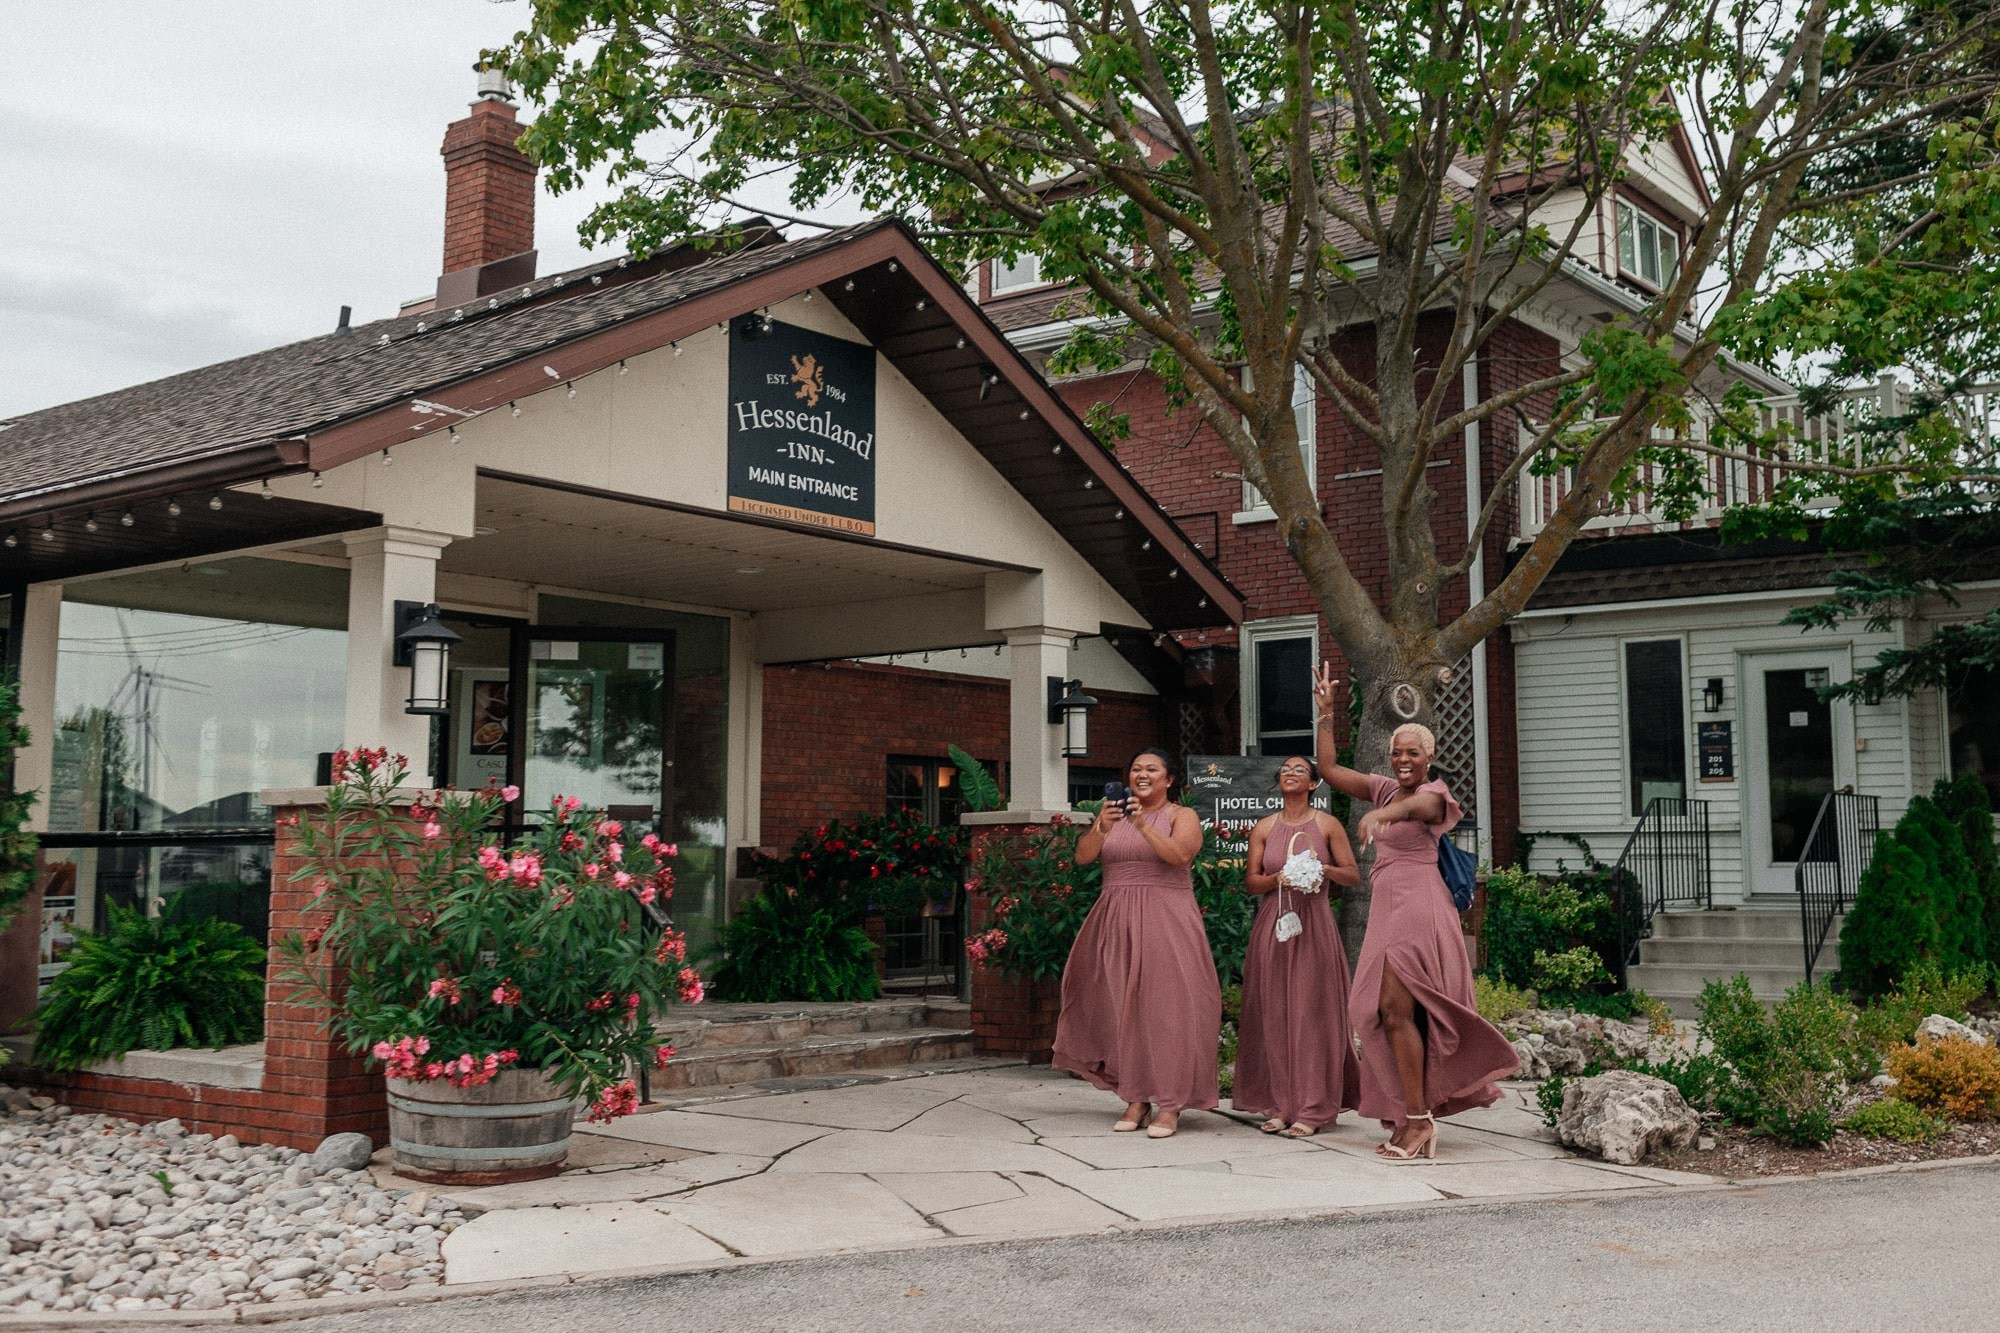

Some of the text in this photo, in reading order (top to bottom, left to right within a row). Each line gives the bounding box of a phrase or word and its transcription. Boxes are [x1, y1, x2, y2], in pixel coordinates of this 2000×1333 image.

[766, 373, 847, 403] EST. 1984
[735, 400, 873, 460] Hessenland
[749, 466, 858, 501] MAIN ENTRANCE
[742, 501, 791, 519] LICENSED
[794, 510, 830, 526] UNDER
[477, 758, 505, 768] CASU
[1708, 755, 1723, 763] 201
[1220, 797, 1263, 809] HOTEL
[1221, 819, 1258, 831] DININ
